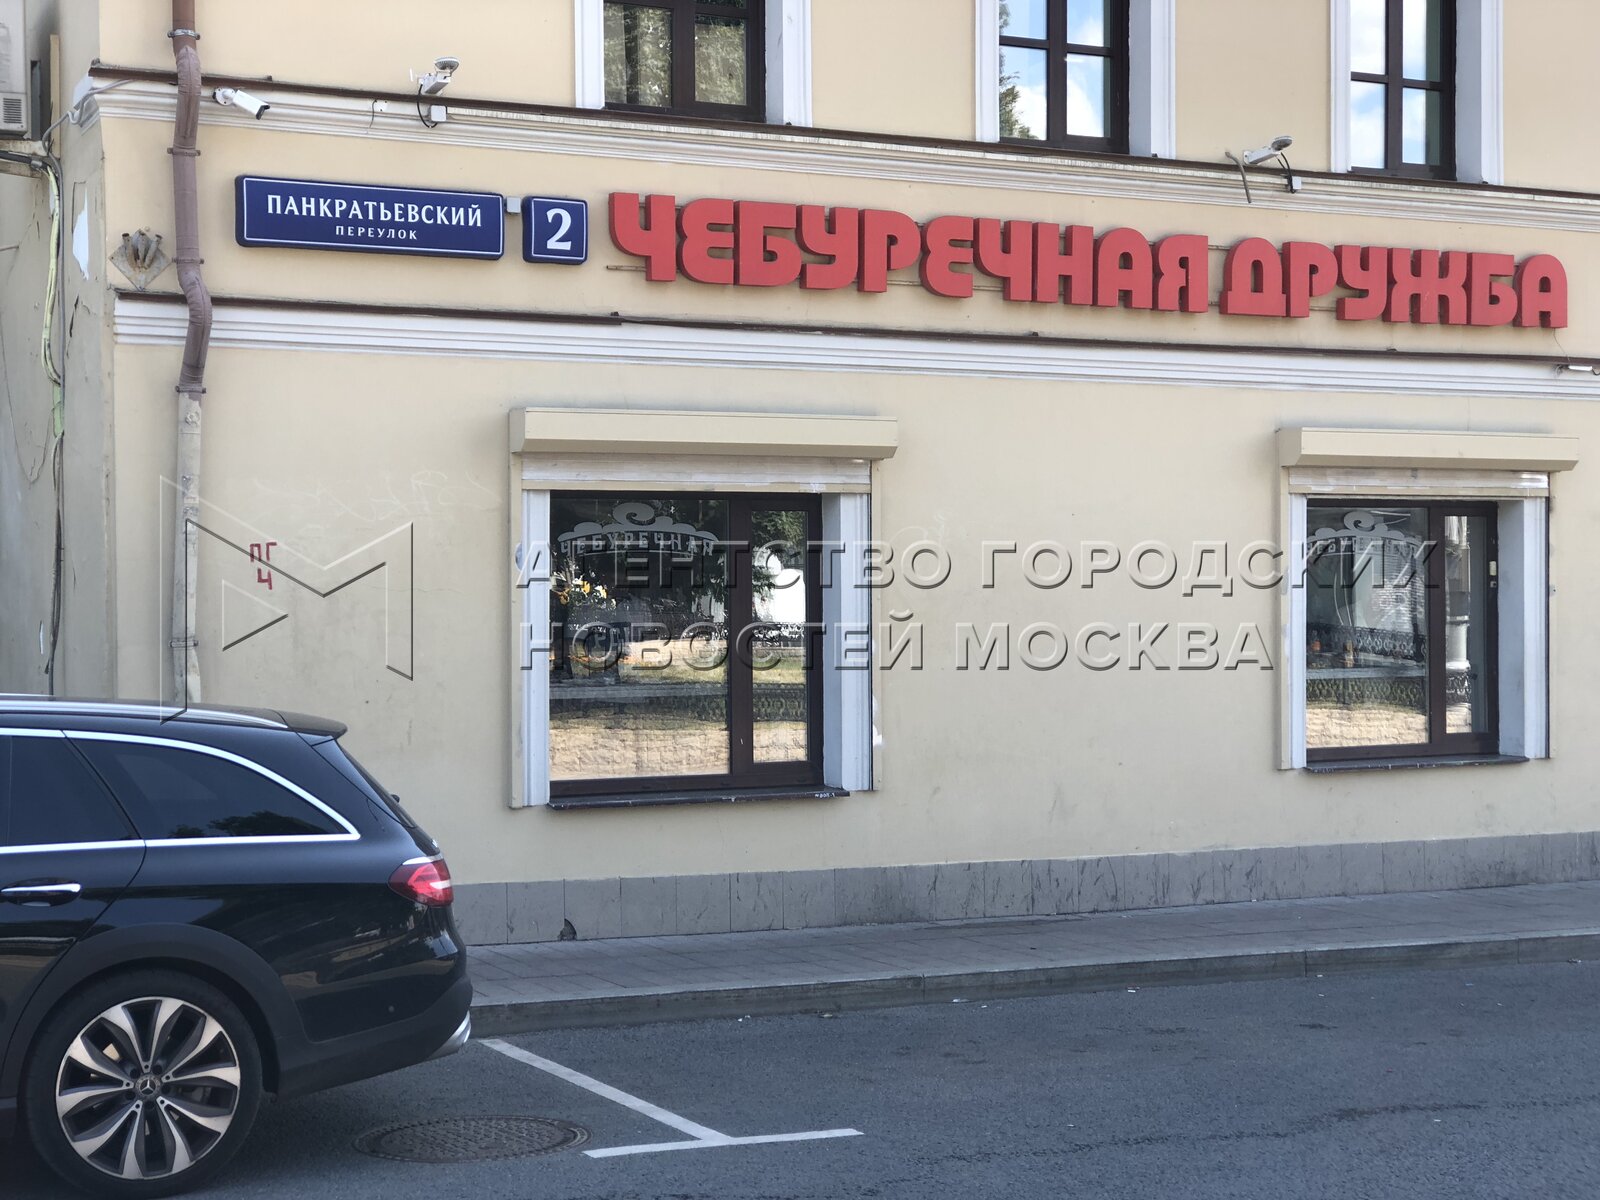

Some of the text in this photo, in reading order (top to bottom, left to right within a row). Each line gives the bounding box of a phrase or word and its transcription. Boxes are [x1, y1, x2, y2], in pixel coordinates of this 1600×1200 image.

[266, 194, 483, 228] ПАНКРАТЬЕВСКИЙ
[335, 225, 418, 240] ПЕРЕУЛОК
[545, 208, 573, 251] 2
[608, 191, 1568, 329] ЧЕБУРЕЧНАЯ ДРУЖБА
[560, 531, 725, 557] ЧЕБУРЕЧНАЯ
